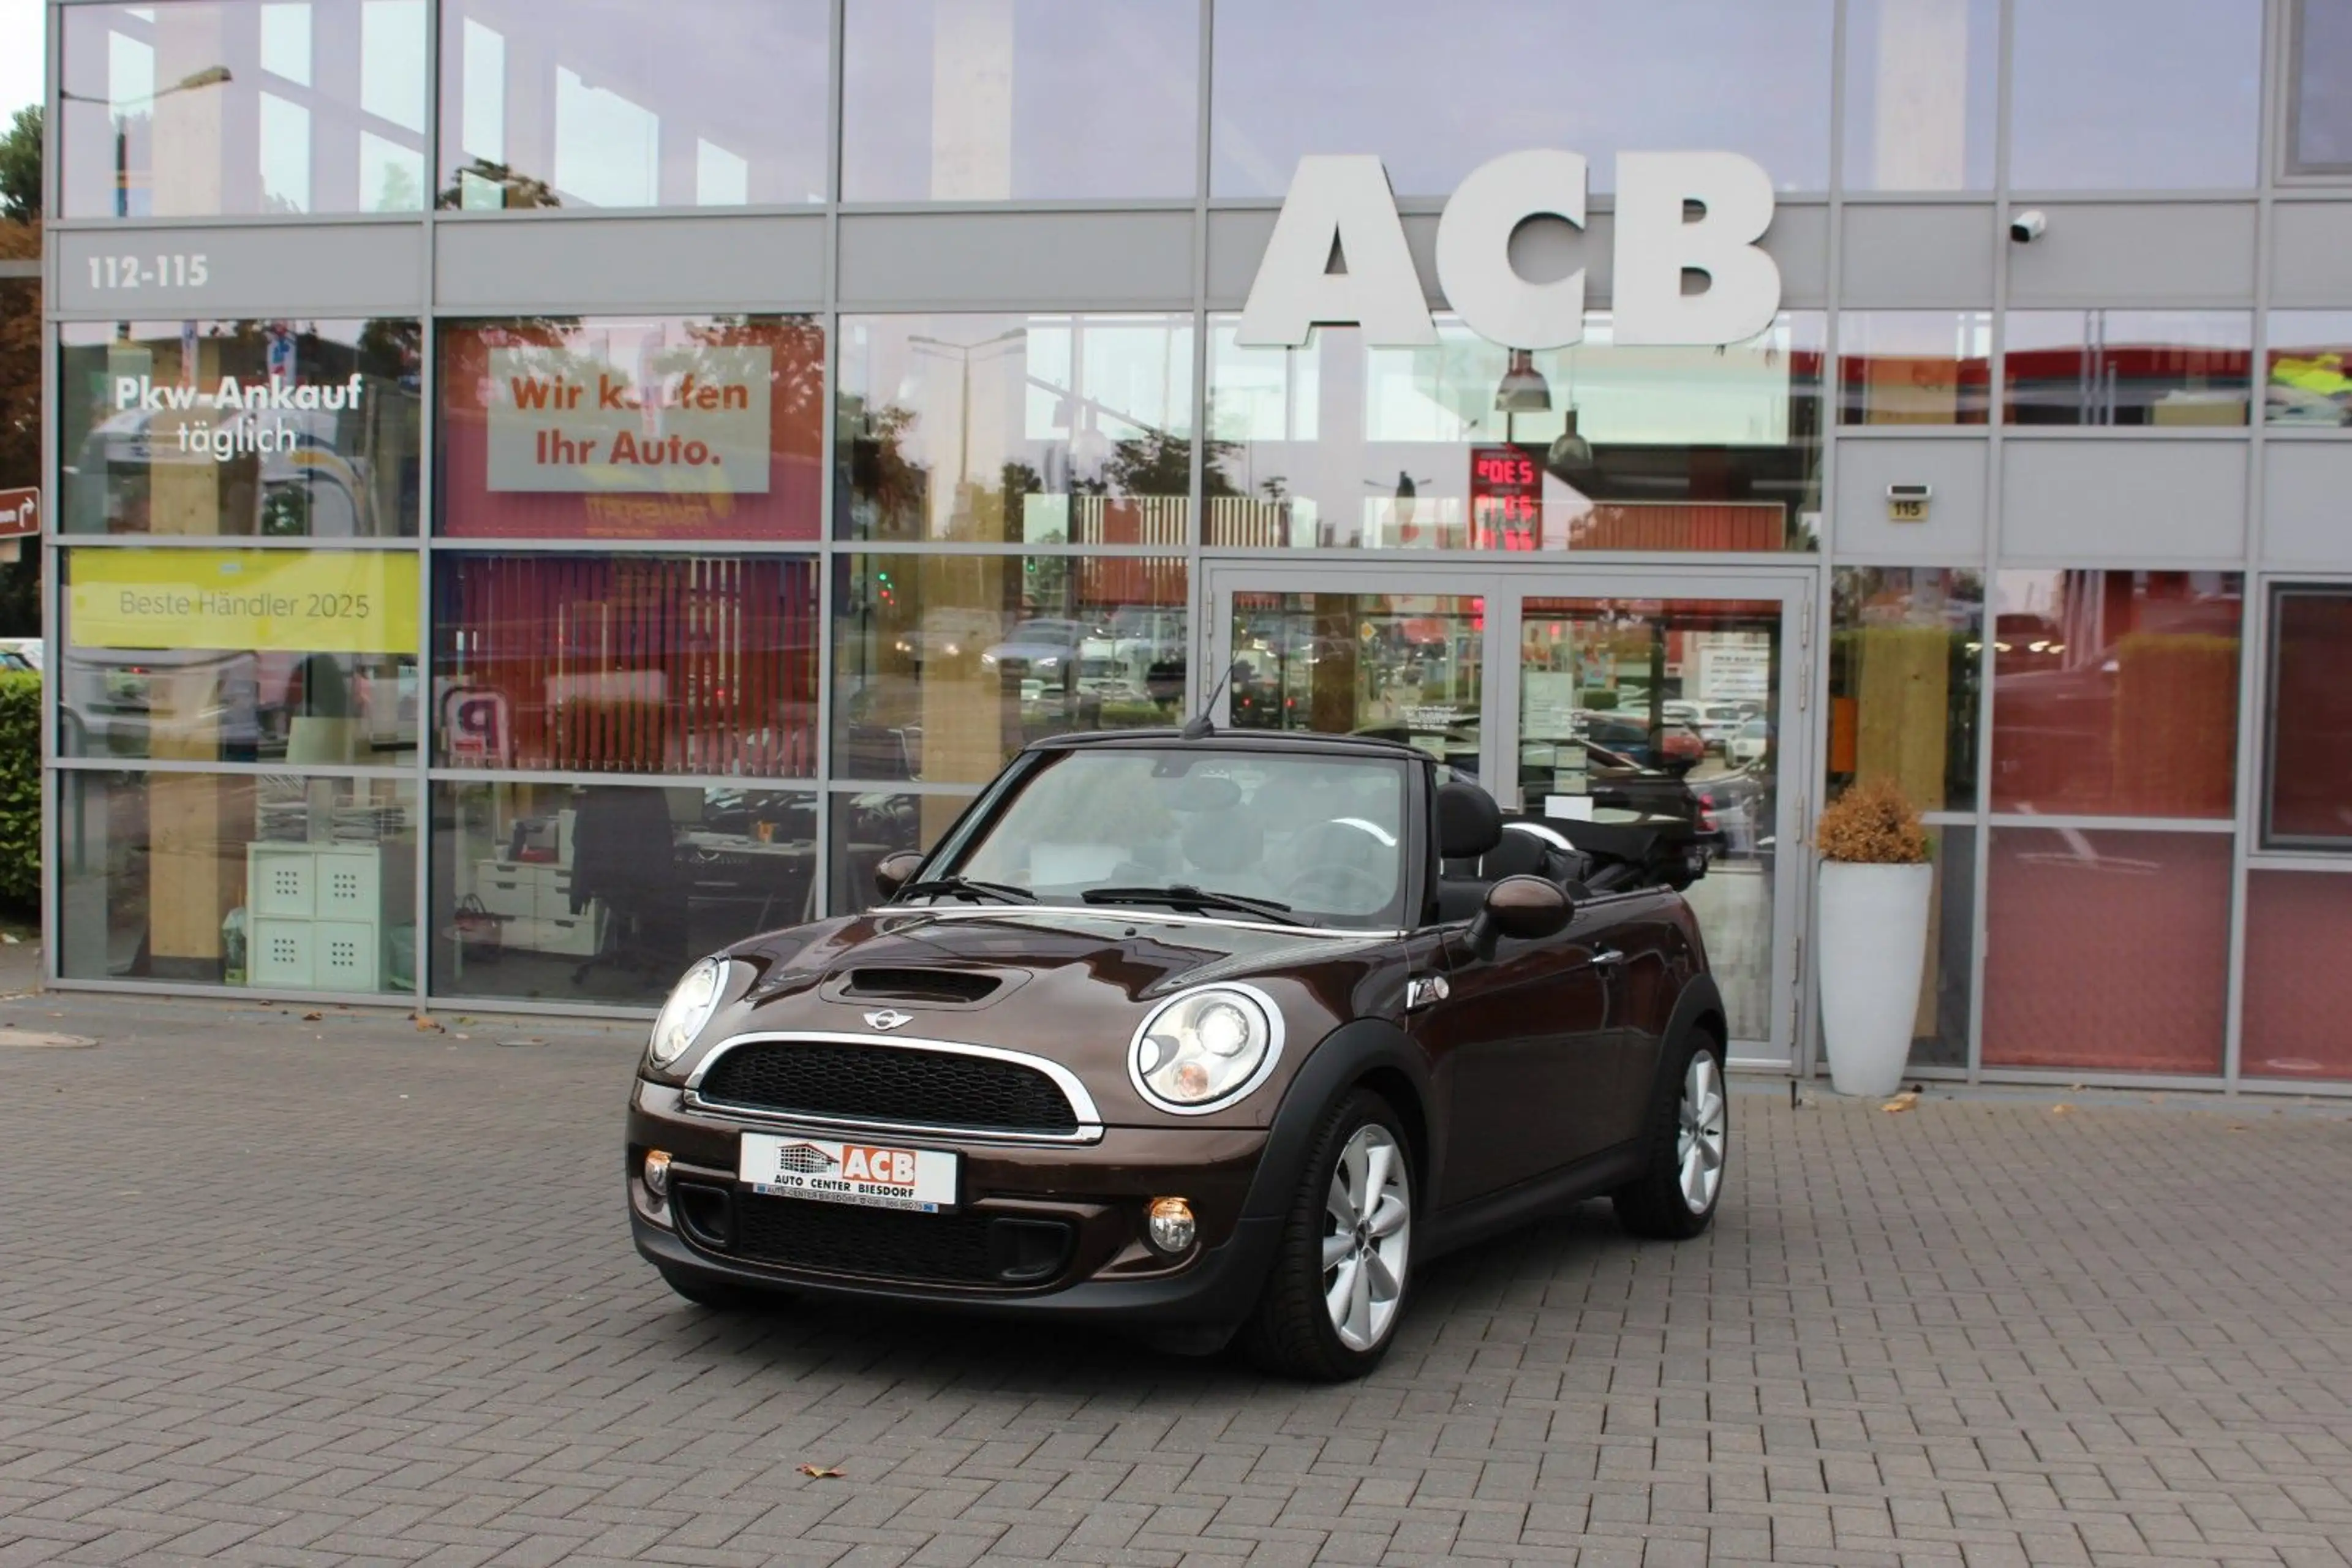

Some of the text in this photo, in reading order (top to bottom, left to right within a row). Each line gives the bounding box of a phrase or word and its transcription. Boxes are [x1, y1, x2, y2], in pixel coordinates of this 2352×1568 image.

[1234, 149, 1782, 350] ACB
[88, 254, 208, 288] 112-115
[115, 374, 363, 411] Pkw-Ankauf
[511, 373, 748, 410] Wir kfen
[178, 418, 297, 462] täglich
[536, 429, 721, 466] Ihr Auto.
[1894, 501, 1921, 516] 115
[120, 591, 370, 618] Beste Händler 2025
[843, 1148, 914, 1183] ACB
[774, 1175, 914, 1199] AUTO CENTER BIESDORF
